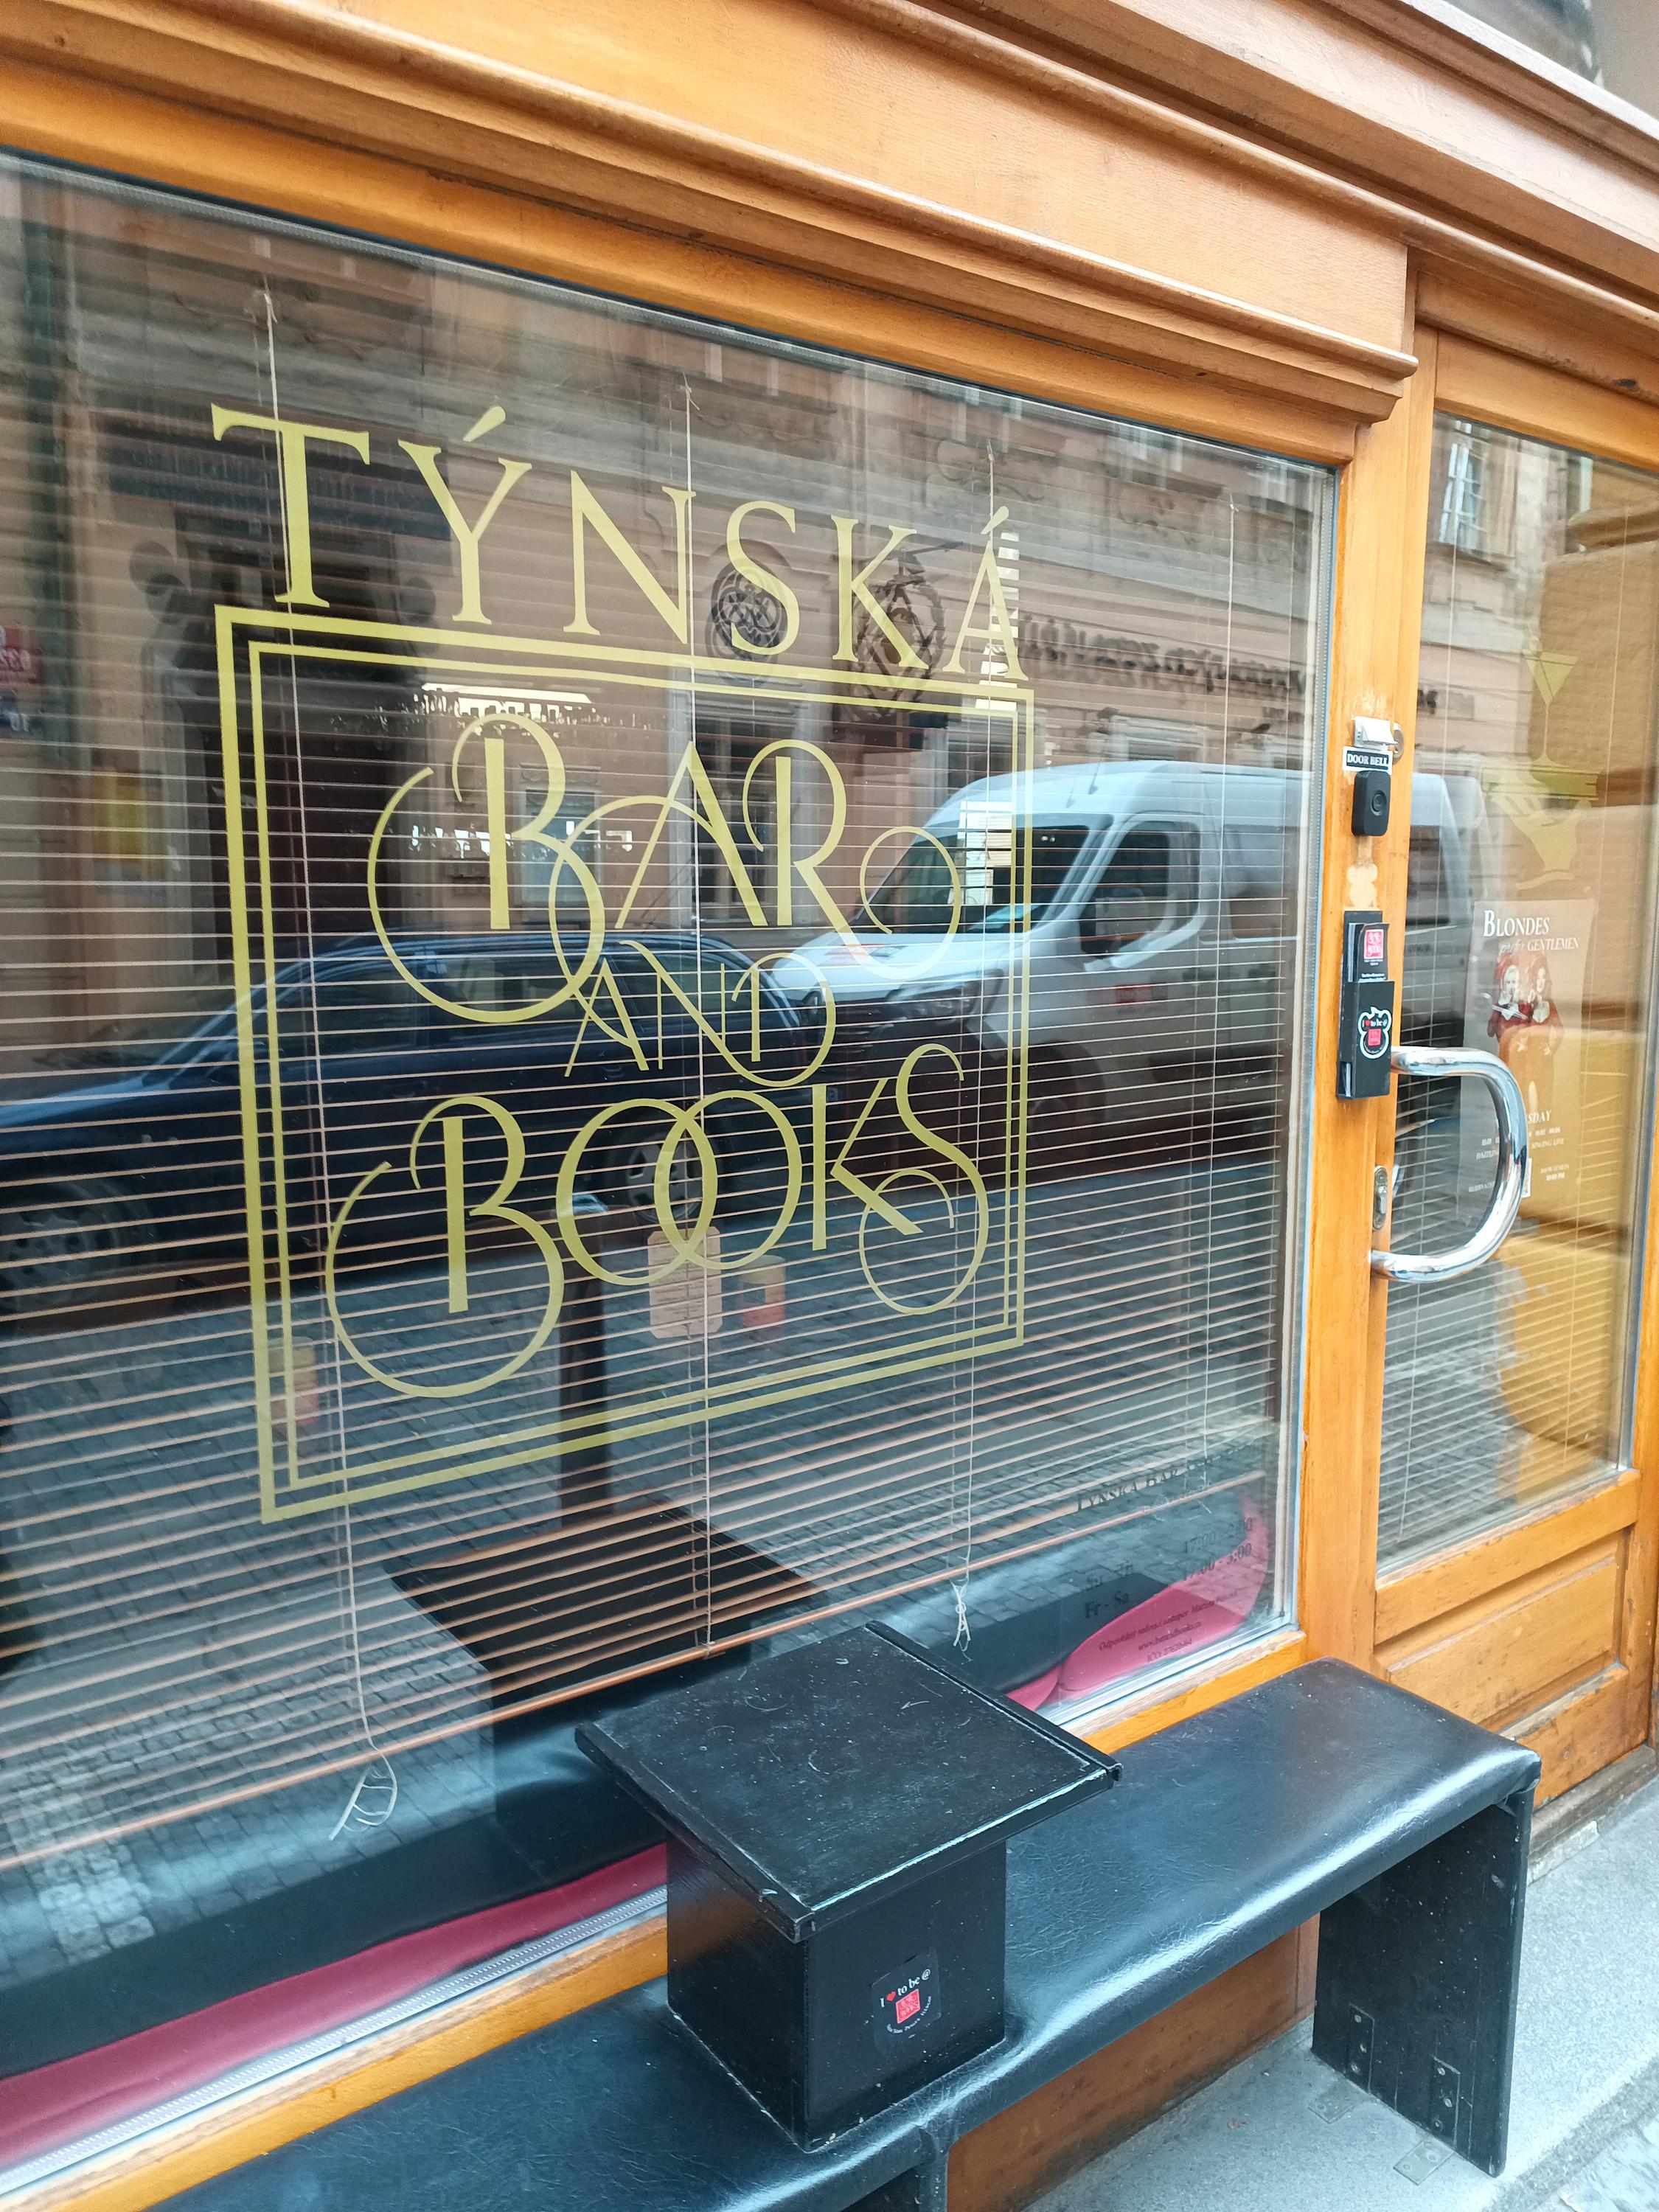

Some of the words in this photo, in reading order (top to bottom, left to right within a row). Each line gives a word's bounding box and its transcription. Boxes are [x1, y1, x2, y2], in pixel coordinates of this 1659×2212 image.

[211, 403, 1029, 681] TÝNSKÁ
[1347, 753, 1369, 765] DOOR
[1370, 756, 1388, 767] BELL
[367, 712, 962, 1023] BAR
[1527, 937, 1579, 952] GENTLEMEN
[565, 940, 836, 1086] AND
[1528, 1110, 1551, 1124] SDAY
[325, 1043, 990, 1397] BOOKS
[880, 1997, 885, 2008] I
[897, 1985, 908, 1996] to
[908, 1976, 920, 1989] be
